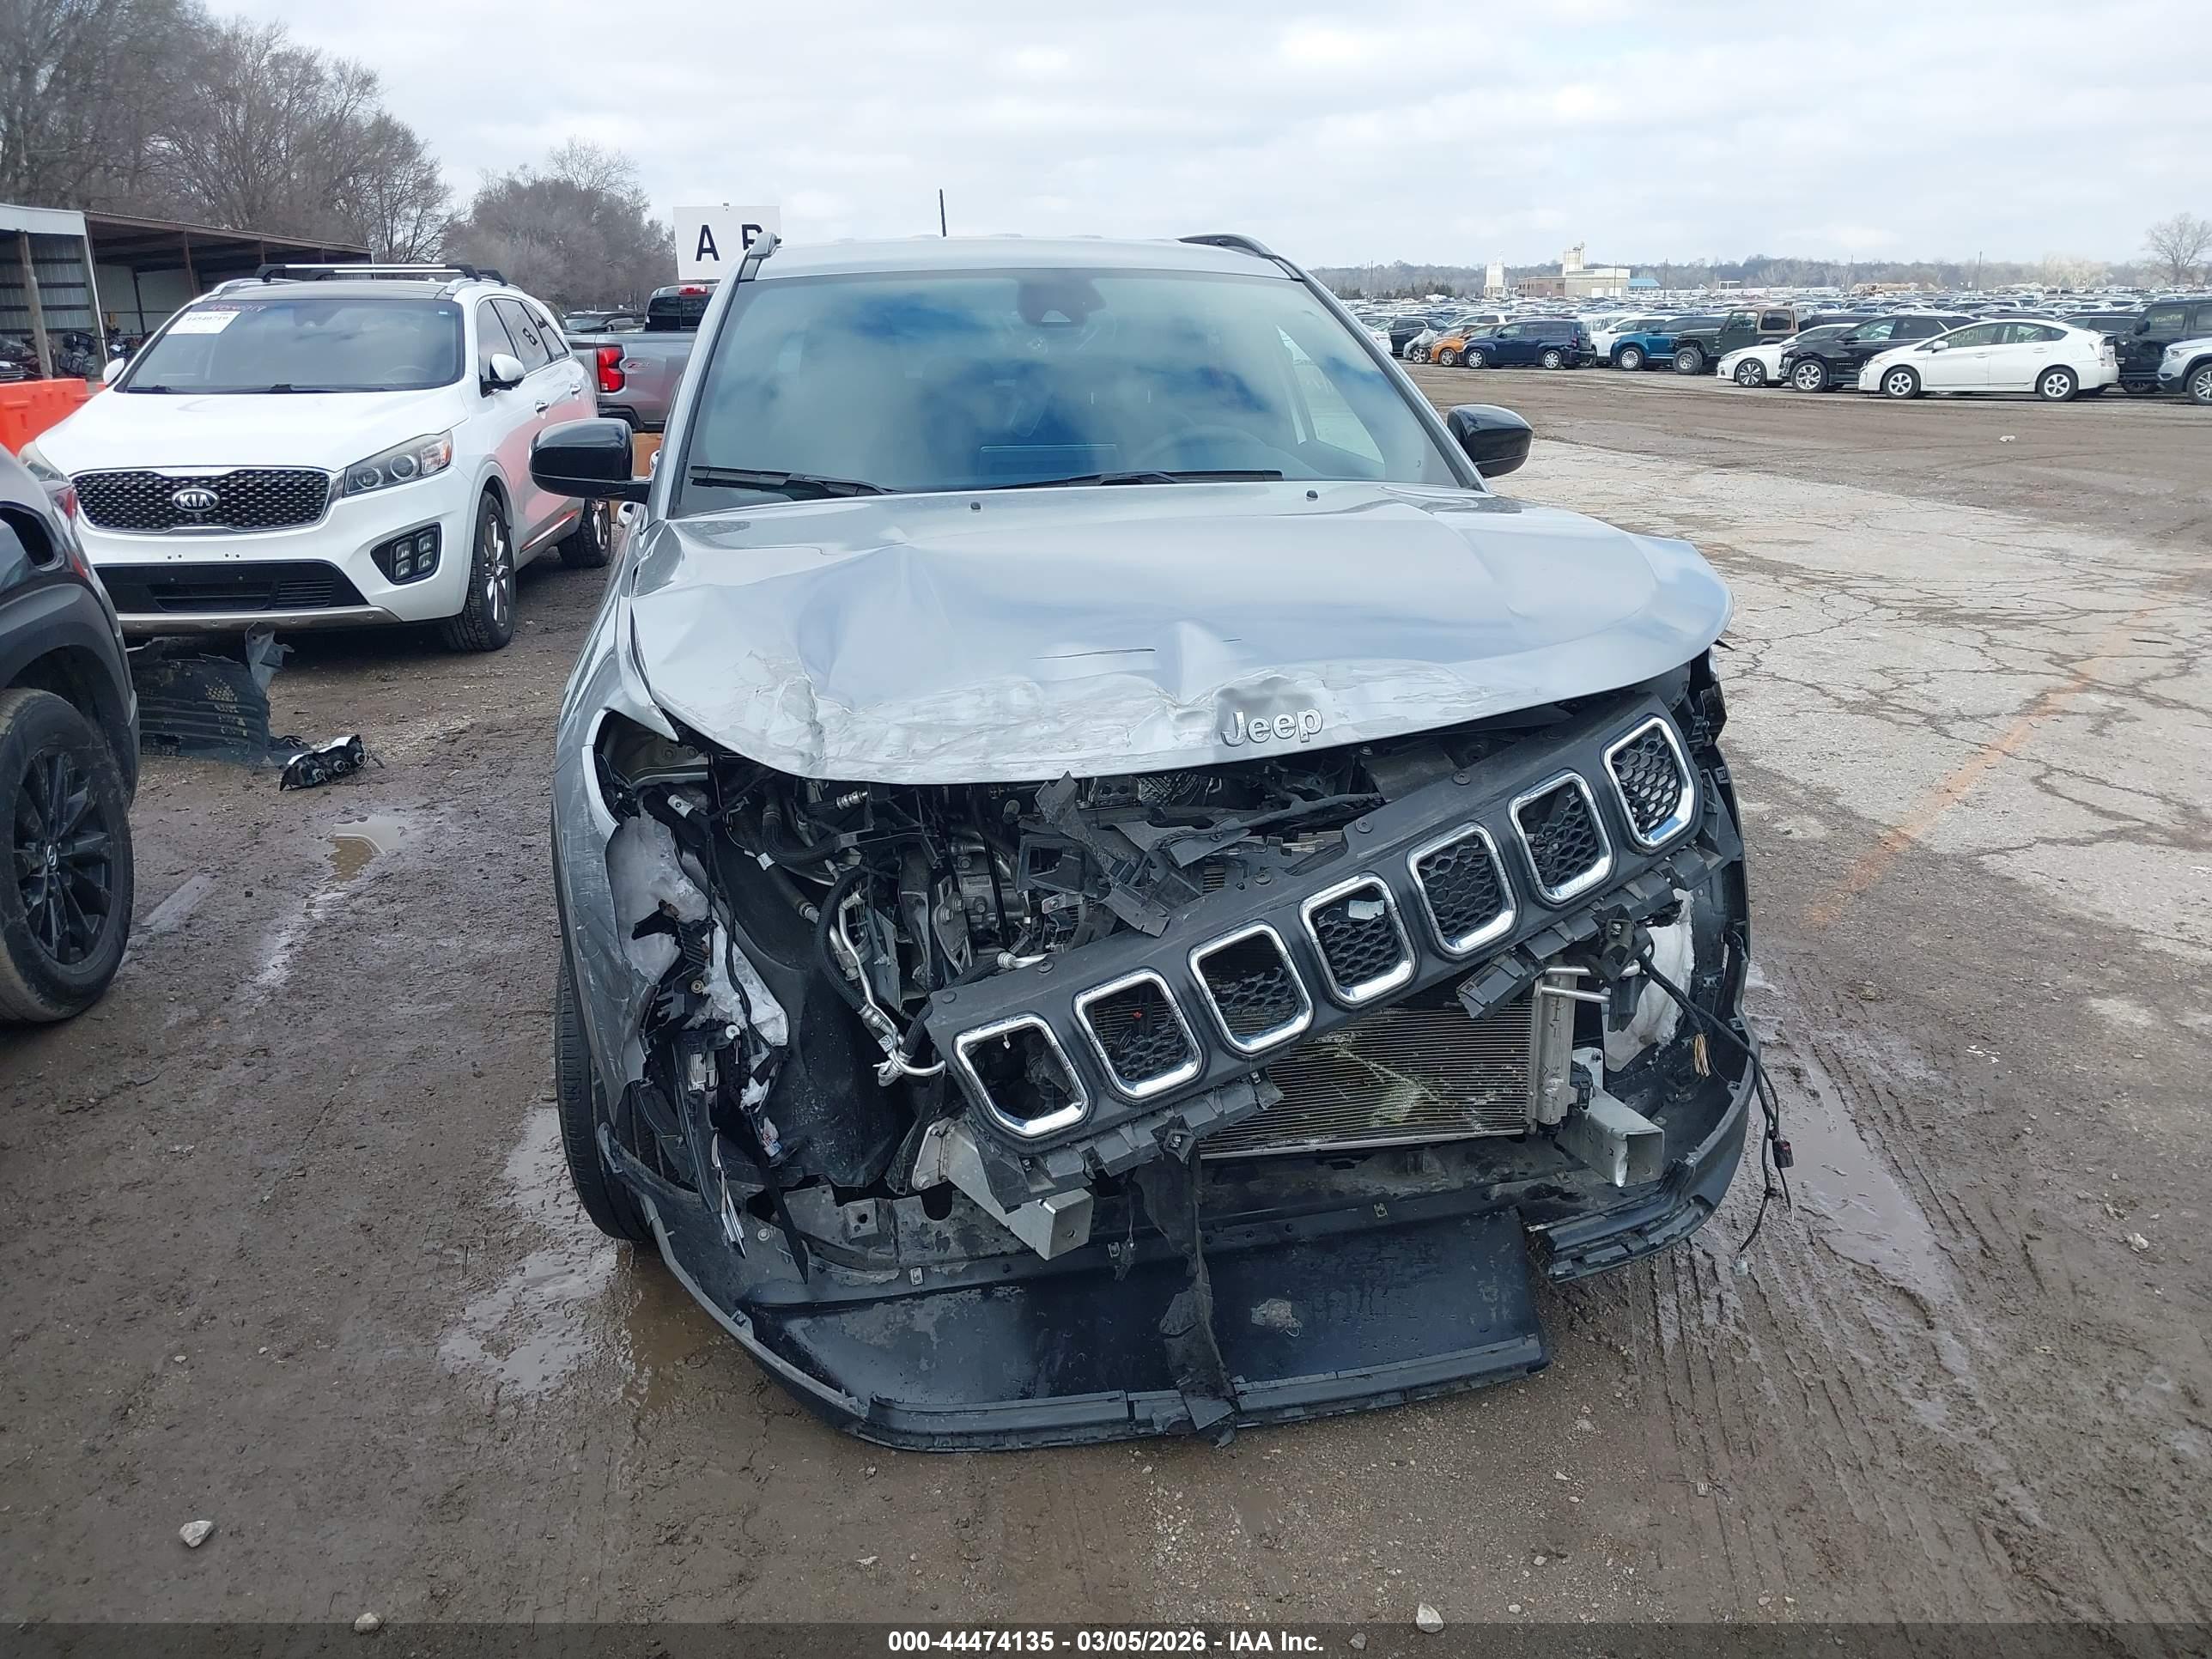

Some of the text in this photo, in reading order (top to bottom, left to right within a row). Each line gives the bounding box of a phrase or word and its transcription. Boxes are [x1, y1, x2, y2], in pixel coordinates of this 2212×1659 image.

[695, 224, 720, 262] A
[179, 494, 211, 507] KIA
[1220, 708, 1322, 747] Jeep
